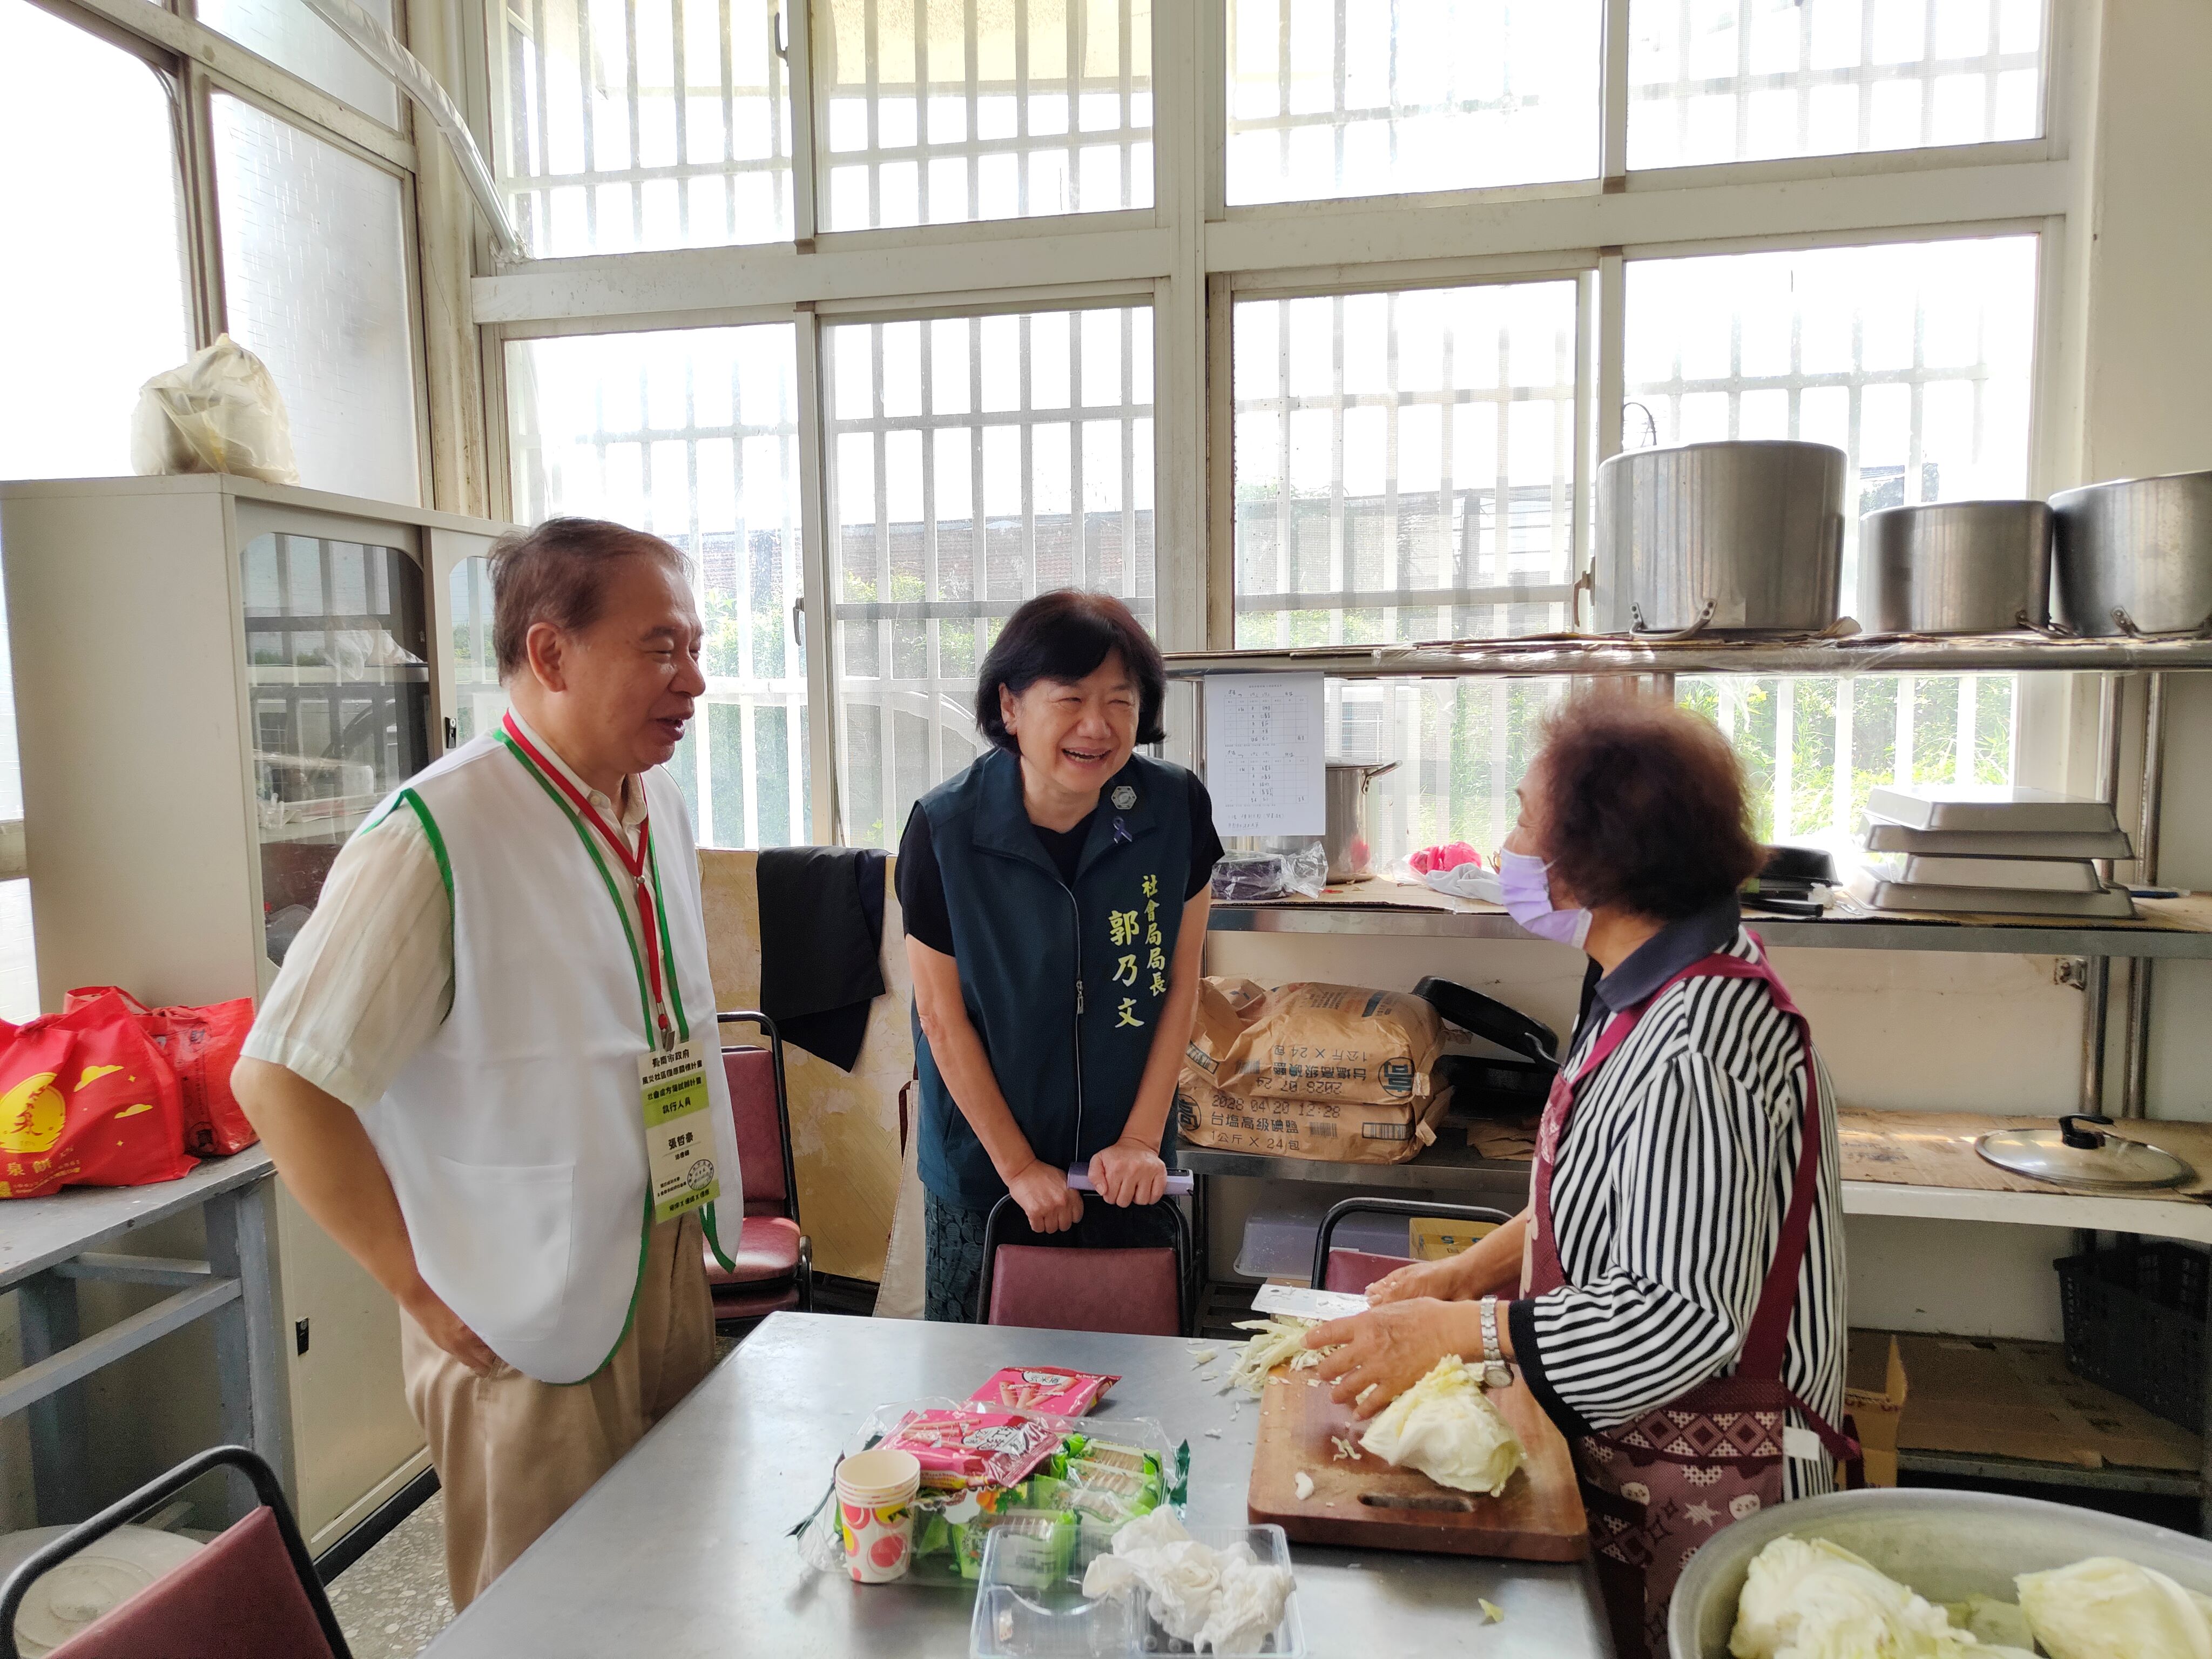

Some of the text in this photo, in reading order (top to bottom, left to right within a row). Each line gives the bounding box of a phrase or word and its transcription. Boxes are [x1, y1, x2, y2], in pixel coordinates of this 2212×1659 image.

[1142, 874, 1166, 997] 社會局局長
[1108, 909, 1145, 1028] 郭乃文
[1273, 1045, 1285, 1056] 包
[1291, 1047, 1308, 1058] 24
[1332, 1049, 1367, 1062] 1公斤
[1251, 1099, 1266, 1112] 04
[1273, 1101, 1290, 1115] 20
[1211, 1131, 1243, 1145] 1公斤
[1267, 1138, 1284, 1149] 24
[1288, 1140, 1300, 1151] 包
